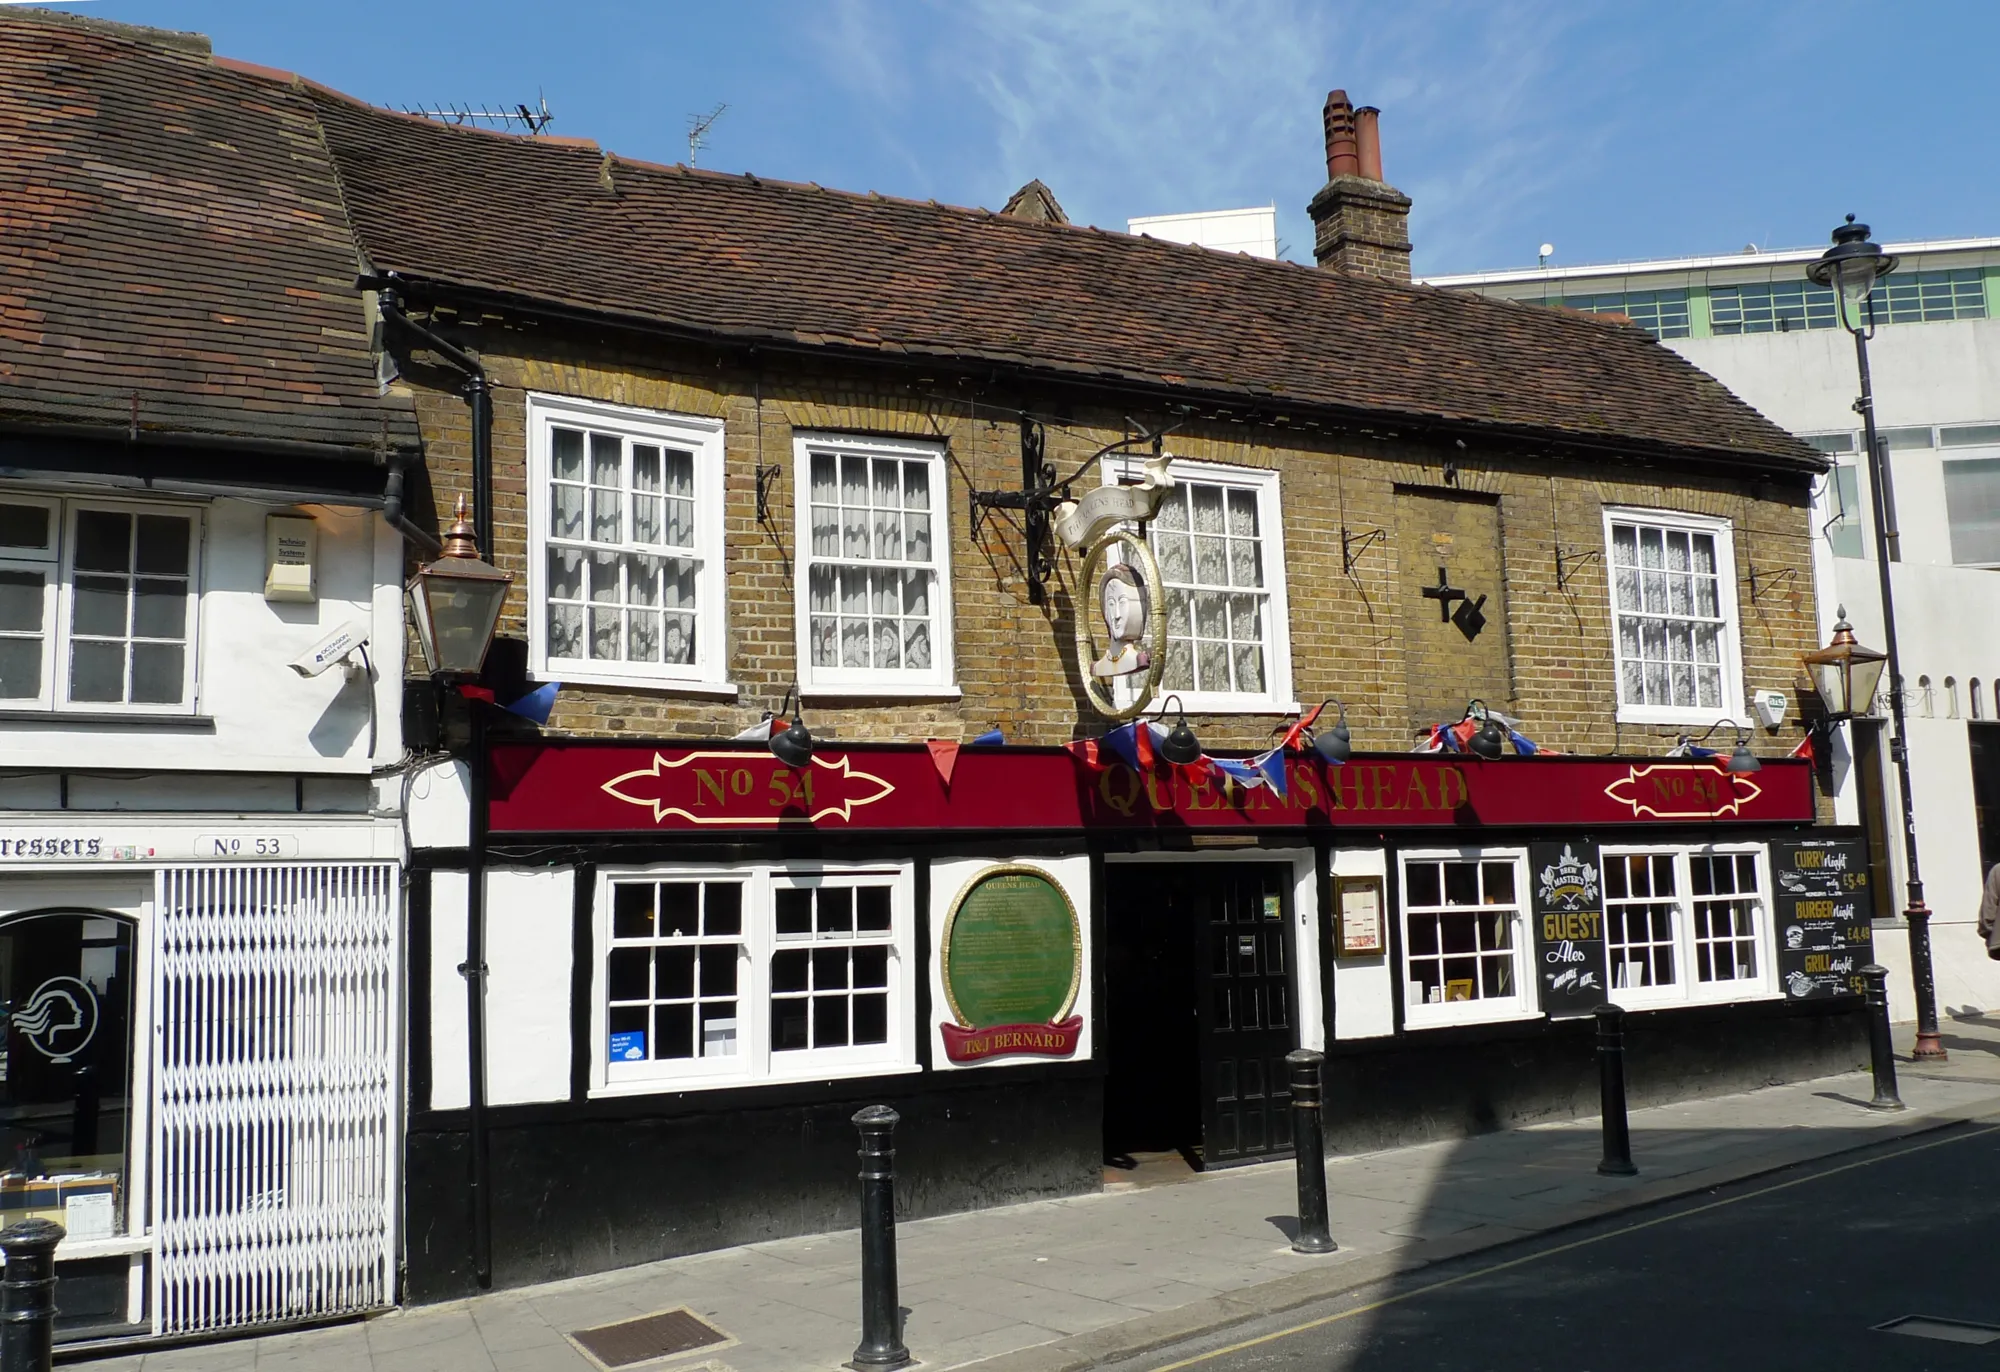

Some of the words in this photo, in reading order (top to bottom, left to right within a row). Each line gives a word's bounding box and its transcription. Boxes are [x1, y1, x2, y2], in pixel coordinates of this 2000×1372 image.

[1113, 497, 1134, 509] HEAD
[768, 769, 816, 807] 54
[1328, 765, 1468, 810] HEAD
[1692, 777, 1719, 805] 54
[255, 839, 280, 854] 53
[1794, 850, 1825, 868] CURRY
[1843, 873, 1866, 890] £5.49
[1795, 901, 1834, 919] BURGER
[1543, 912, 1601, 940] GUEST
[1847, 926, 1870, 943] £4.49
[1546, 940, 1585, 963] Ales
[1805, 954, 1831, 972] GRILL
[964, 1037, 989, 1054] T&J
[994, 1032, 1065, 1048] BERNARD
